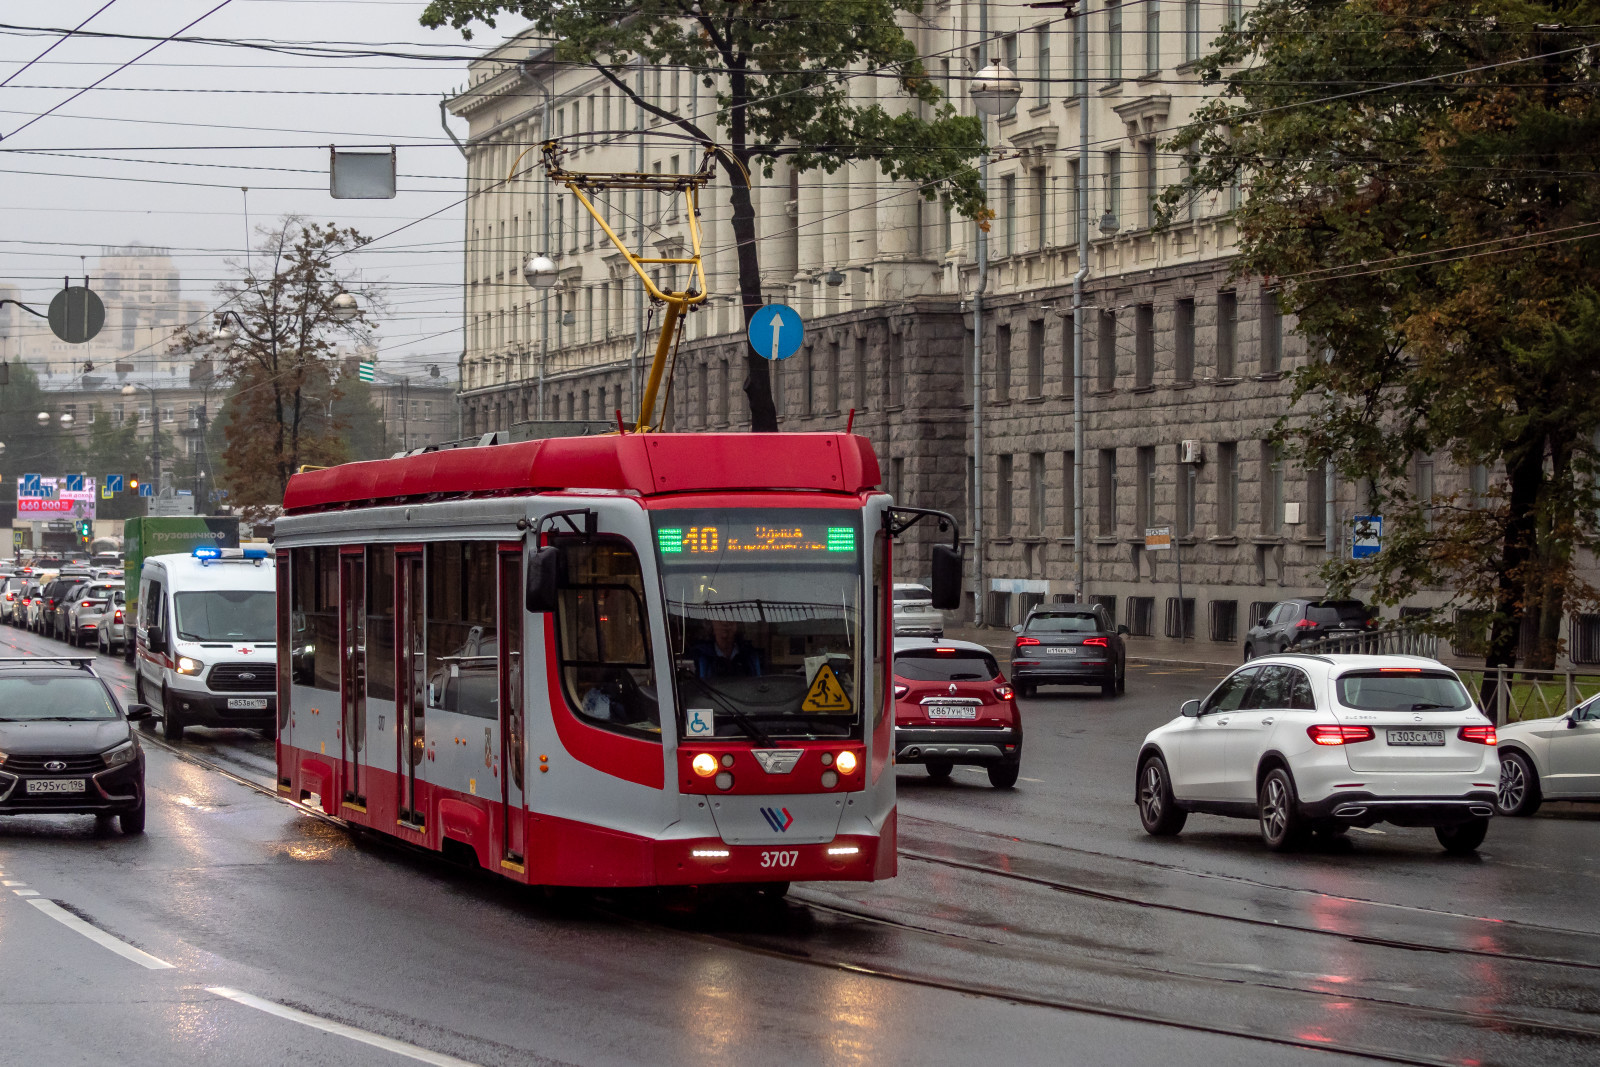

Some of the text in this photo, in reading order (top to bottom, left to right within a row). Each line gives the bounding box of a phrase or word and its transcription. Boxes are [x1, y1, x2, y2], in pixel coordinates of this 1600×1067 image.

[21, 501, 40, 510] 660
[42, 501, 61, 510] 000
[152, 531, 225, 541] грузовичкоф
[1390, 731, 1443, 742] Т303СА 178
[29, 781, 67, 791] В295УС
[760, 851, 799, 867] 3707
